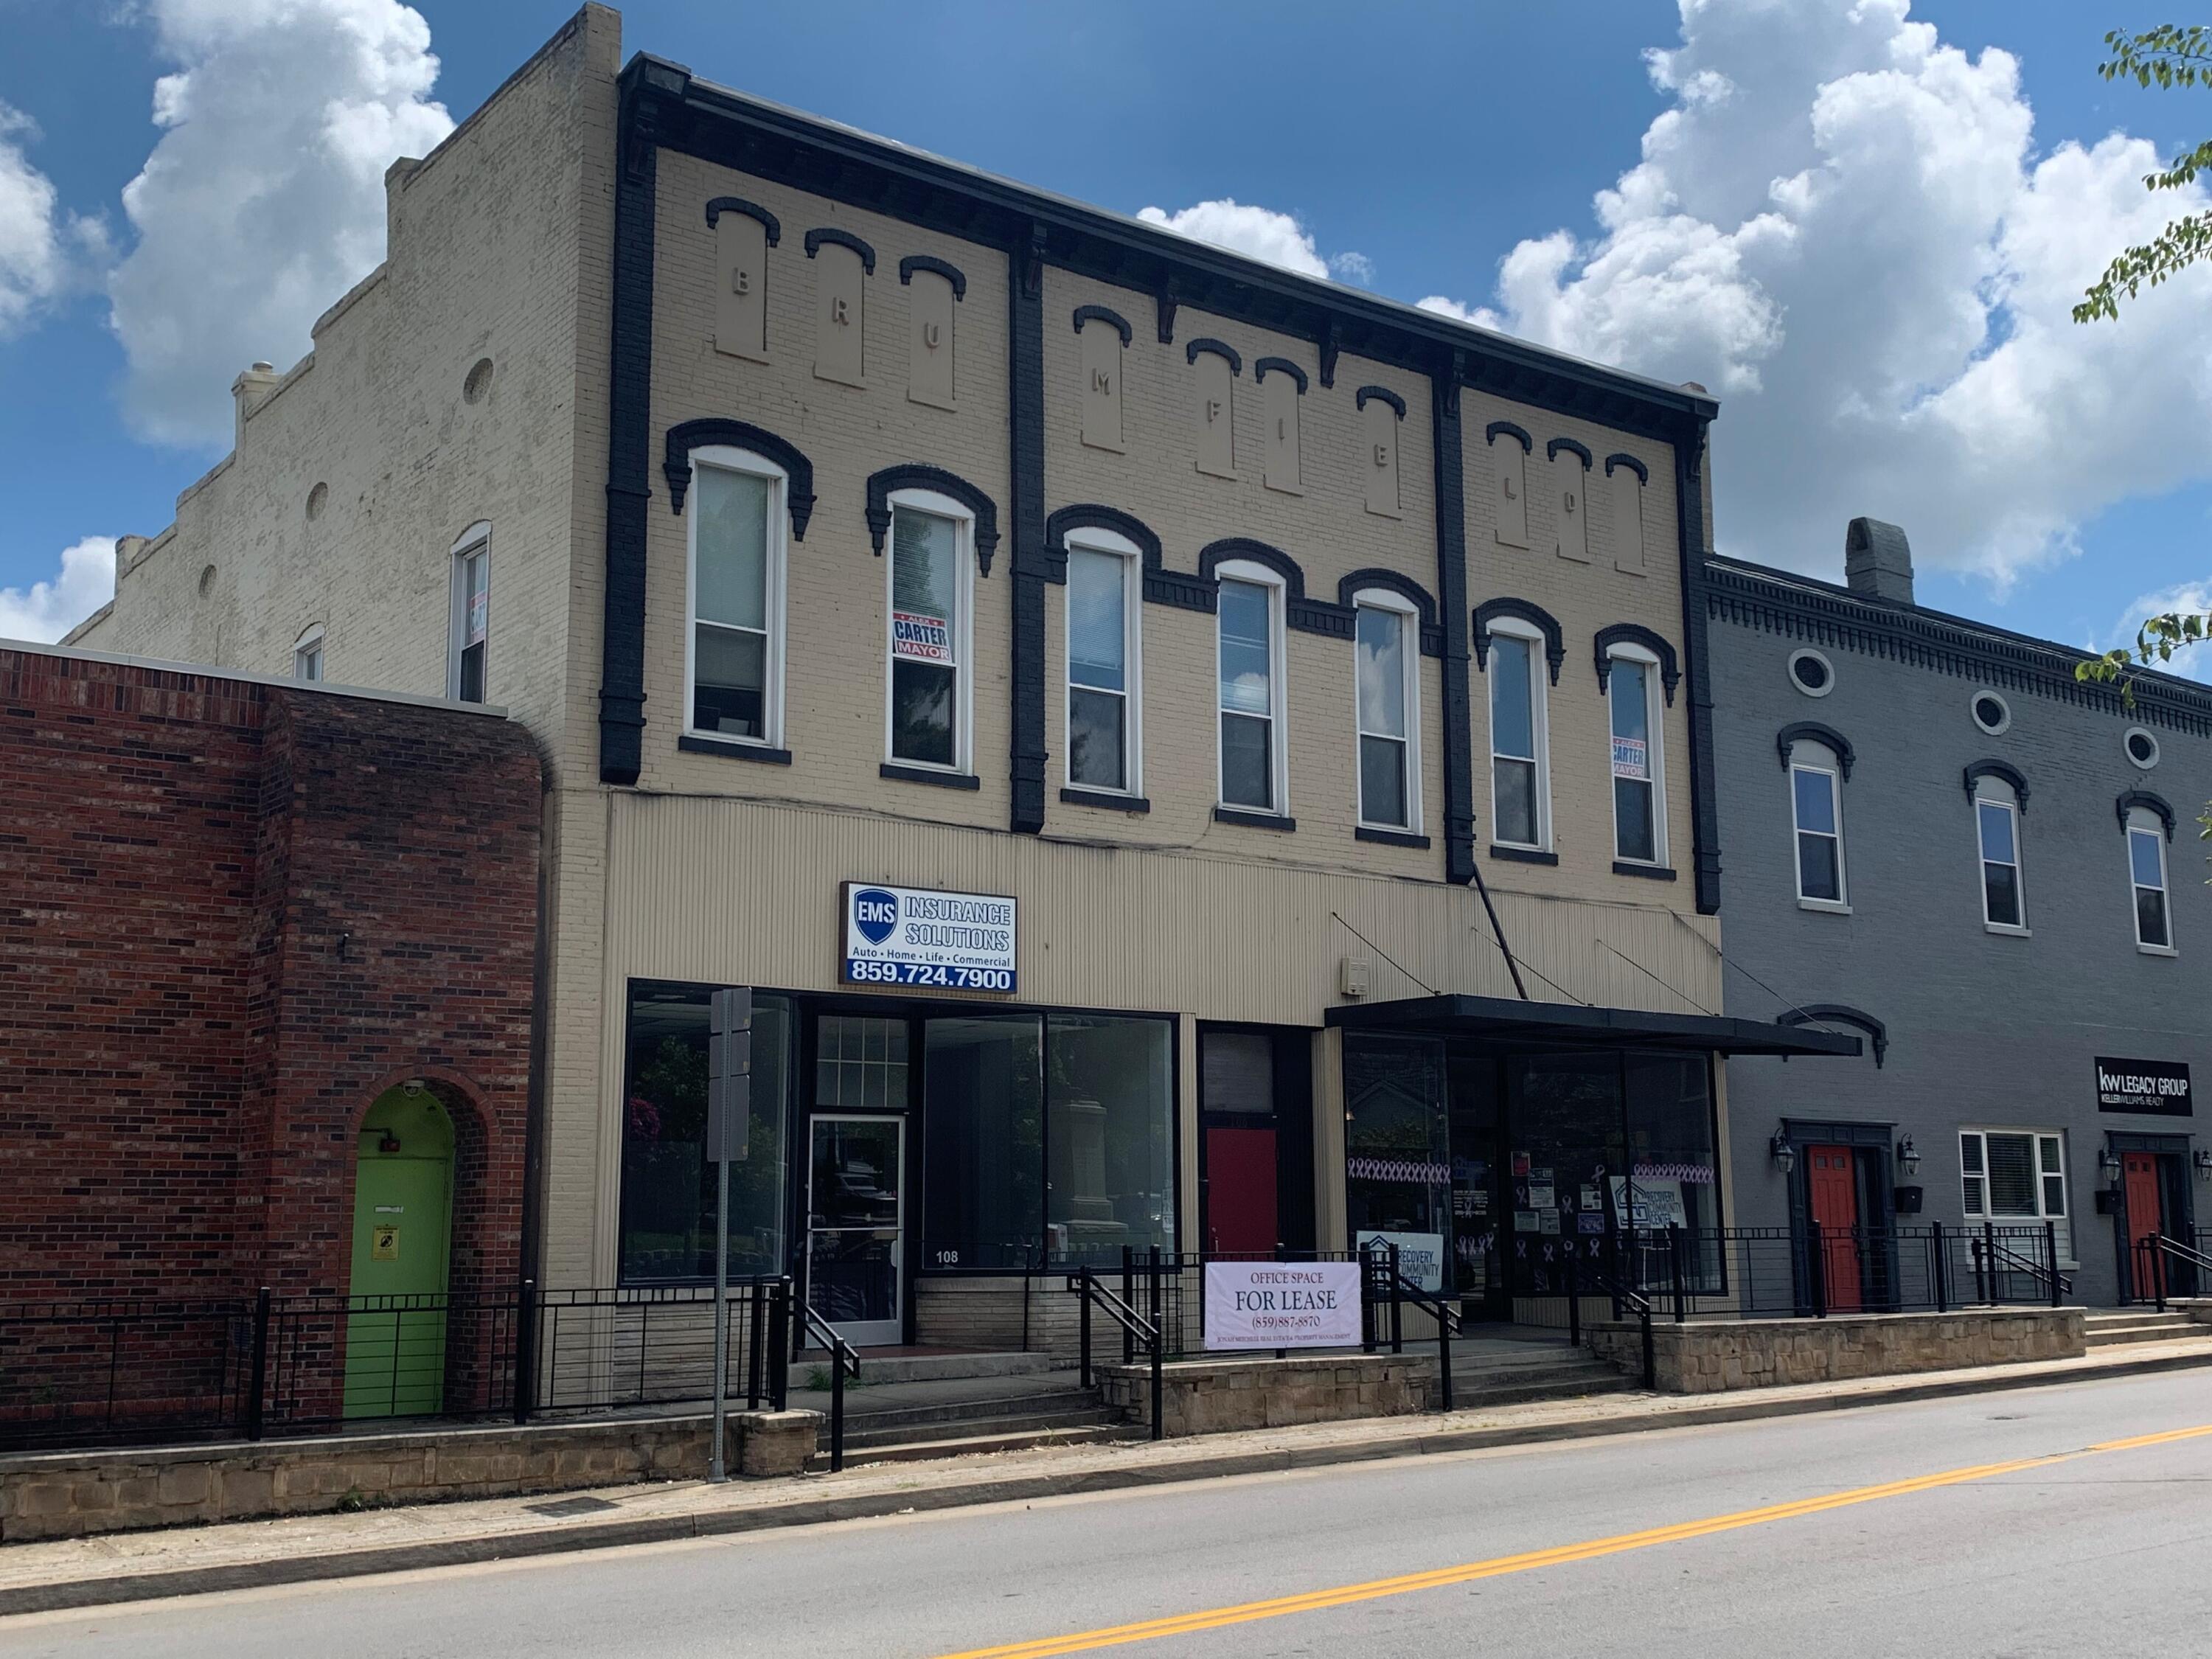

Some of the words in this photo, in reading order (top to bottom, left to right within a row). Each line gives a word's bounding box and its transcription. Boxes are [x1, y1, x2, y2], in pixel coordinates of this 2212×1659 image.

[832, 296, 849, 326] R
[924, 321, 941, 349] U
[908, 616, 930, 625] ALEX
[894, 621, 947, 647] CARTER
[898, 641, 949, 658] MAYOR
[858, 900, 895, 923] EMS
[905, 896, 1010, 925] INSURANCE
[905, 923, 1009, 951] SOLUTIONS
[852, 947, 877, 957] Auto
[887, 949, 916, 960] Home
[926, 952, 944, 962] Life
[953, 955, 1010, 967] Commercial
[852, 961, 1011, 990] 859.724.7900
[2121, 1075, 2157, 1094] LEGACY
[2157, 1077, 2188, 1096] GROUP
[936, 1250, 959, 1263] 108
[1398, 1250, 1434, 1263] RECOVERY
[1251, 1272, 1290, 1284] OFFICE
[1291, 1272, 1324, 1284] SPACE
[1235, 1290, 1276, 1311] FOR
[1281, 1290, 1338, 1310] LEASE
